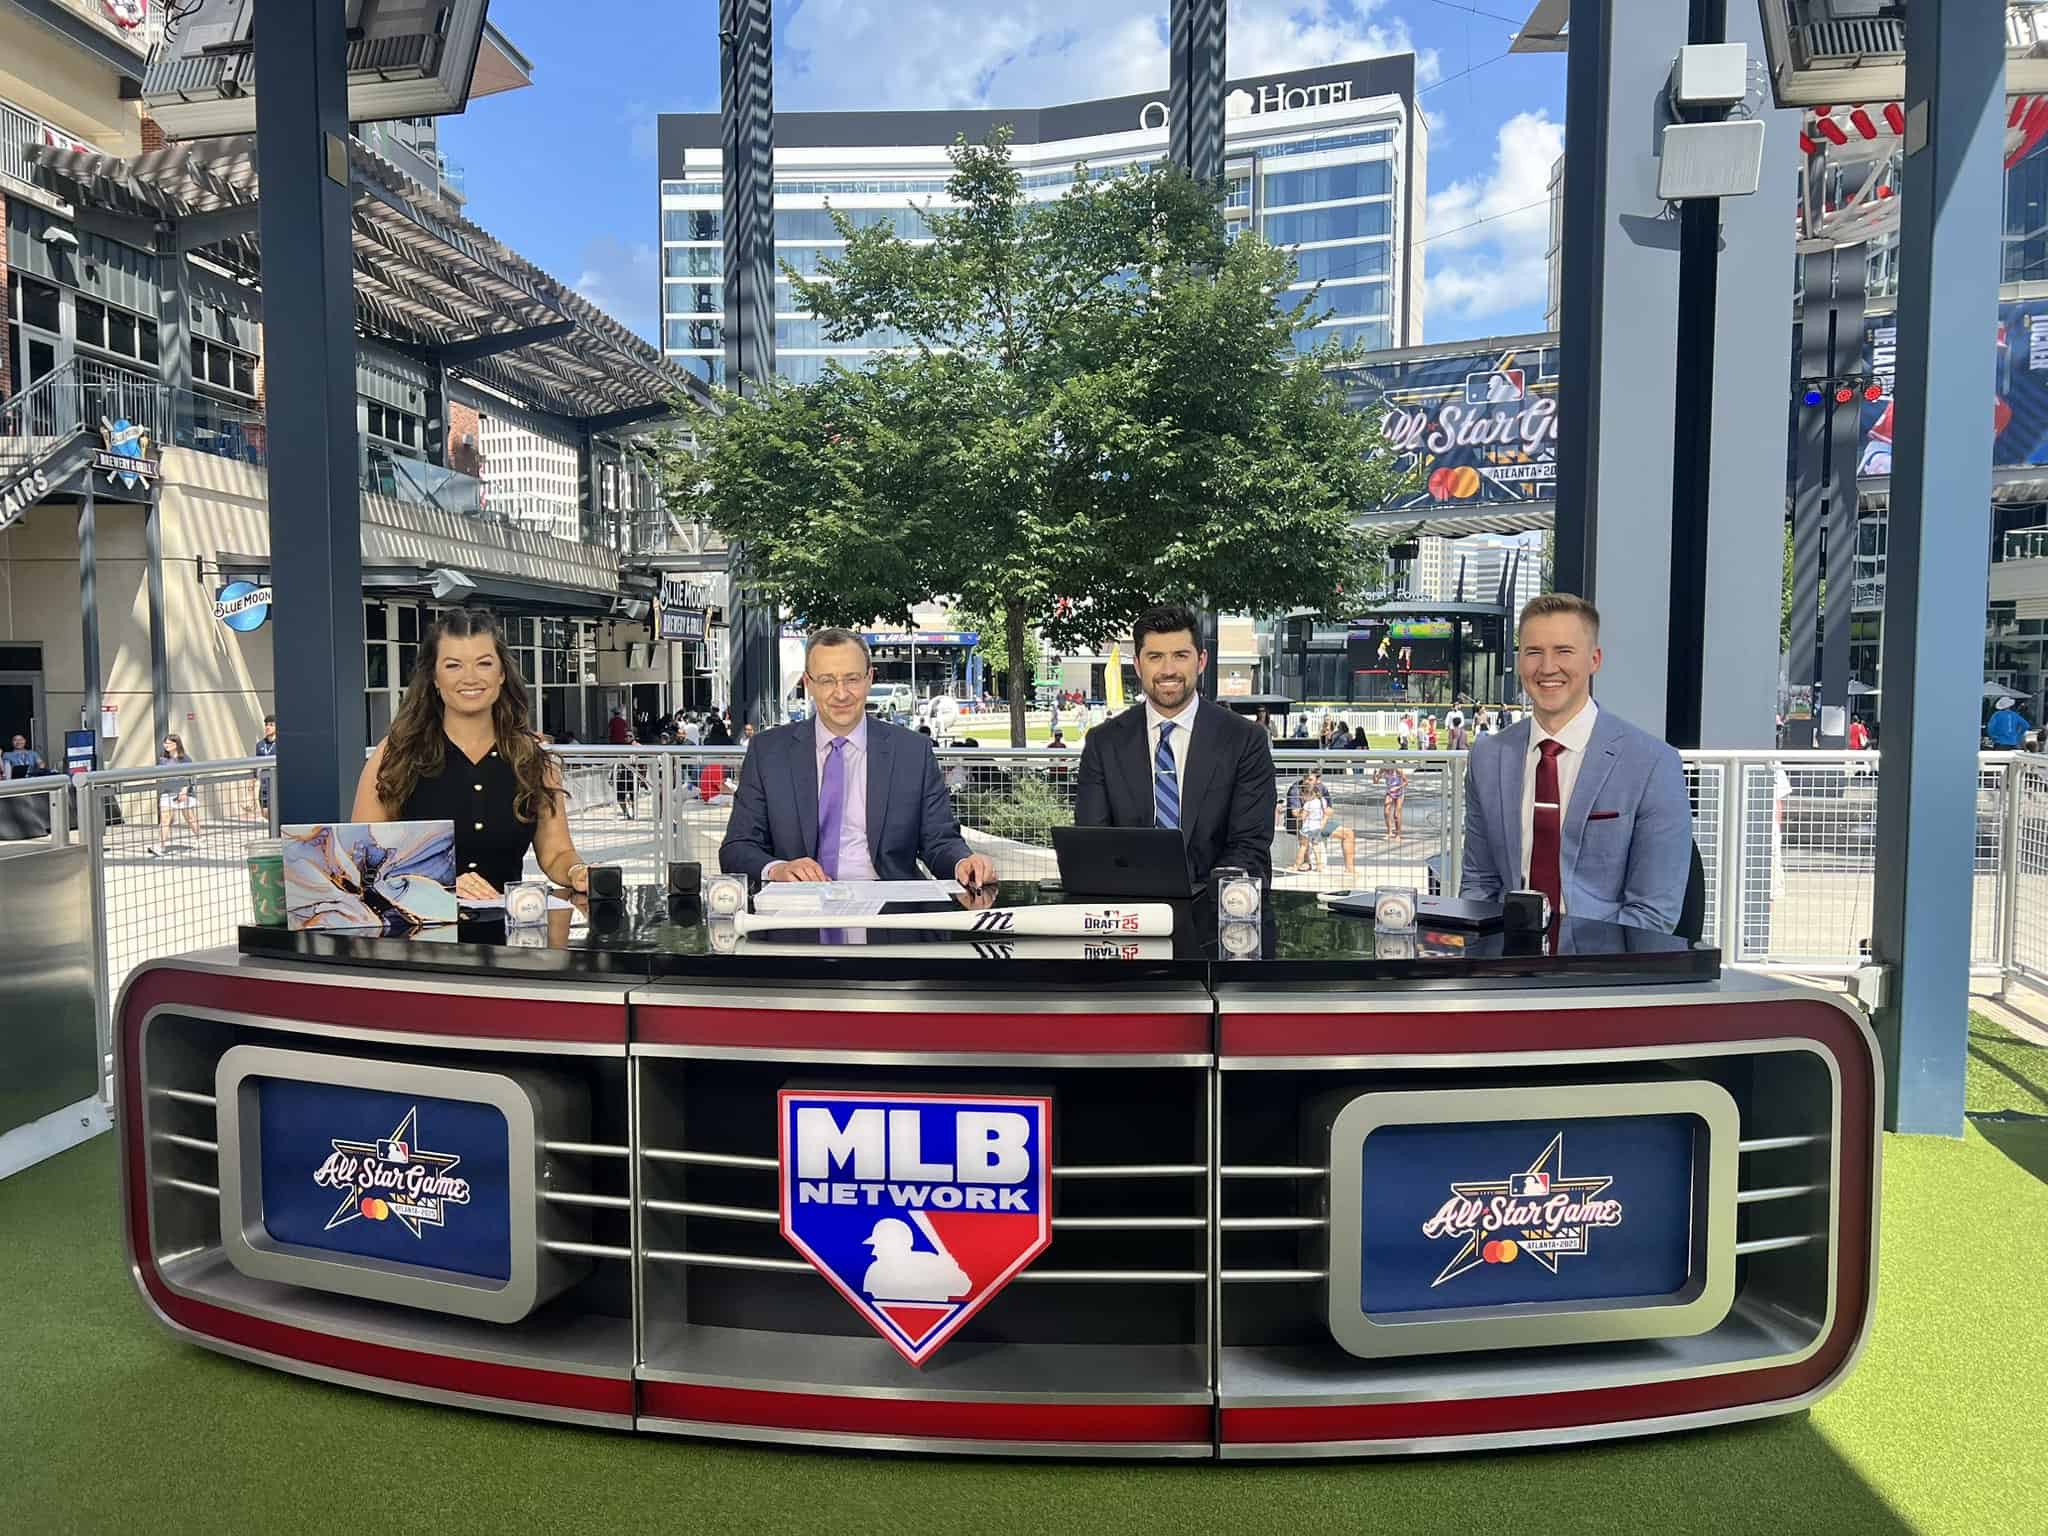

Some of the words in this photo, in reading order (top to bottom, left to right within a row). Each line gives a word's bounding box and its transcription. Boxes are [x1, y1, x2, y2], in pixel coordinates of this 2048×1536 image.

[1257, 81, 1353, 113] HOTEL
[1427, 404, 1516, 454] Star
[1493, 467, 1537, 480] ATLANTA
[214, 599, 243, 618] BLUE
[243, 591, 271, 608] MOON
[660, 571, 683, 610] BLUE
[1084, 917, 1120, 929] DRAFT
[1121, 918, 1139, 930] 25
[797, 1107, 1031, 1185] MLB
[313, 1151, 358, 1187] All
[358, 1158, 405, 1190] Star
[404, 1165, 470, 1200] Game
[799, 1182, 1031, 1211] NETWORK
[1423, 1196, 1483, 1234] All
[1482, 1197, 1543, 1231] Star
[1542, 1193, 1620, 1232] Game
